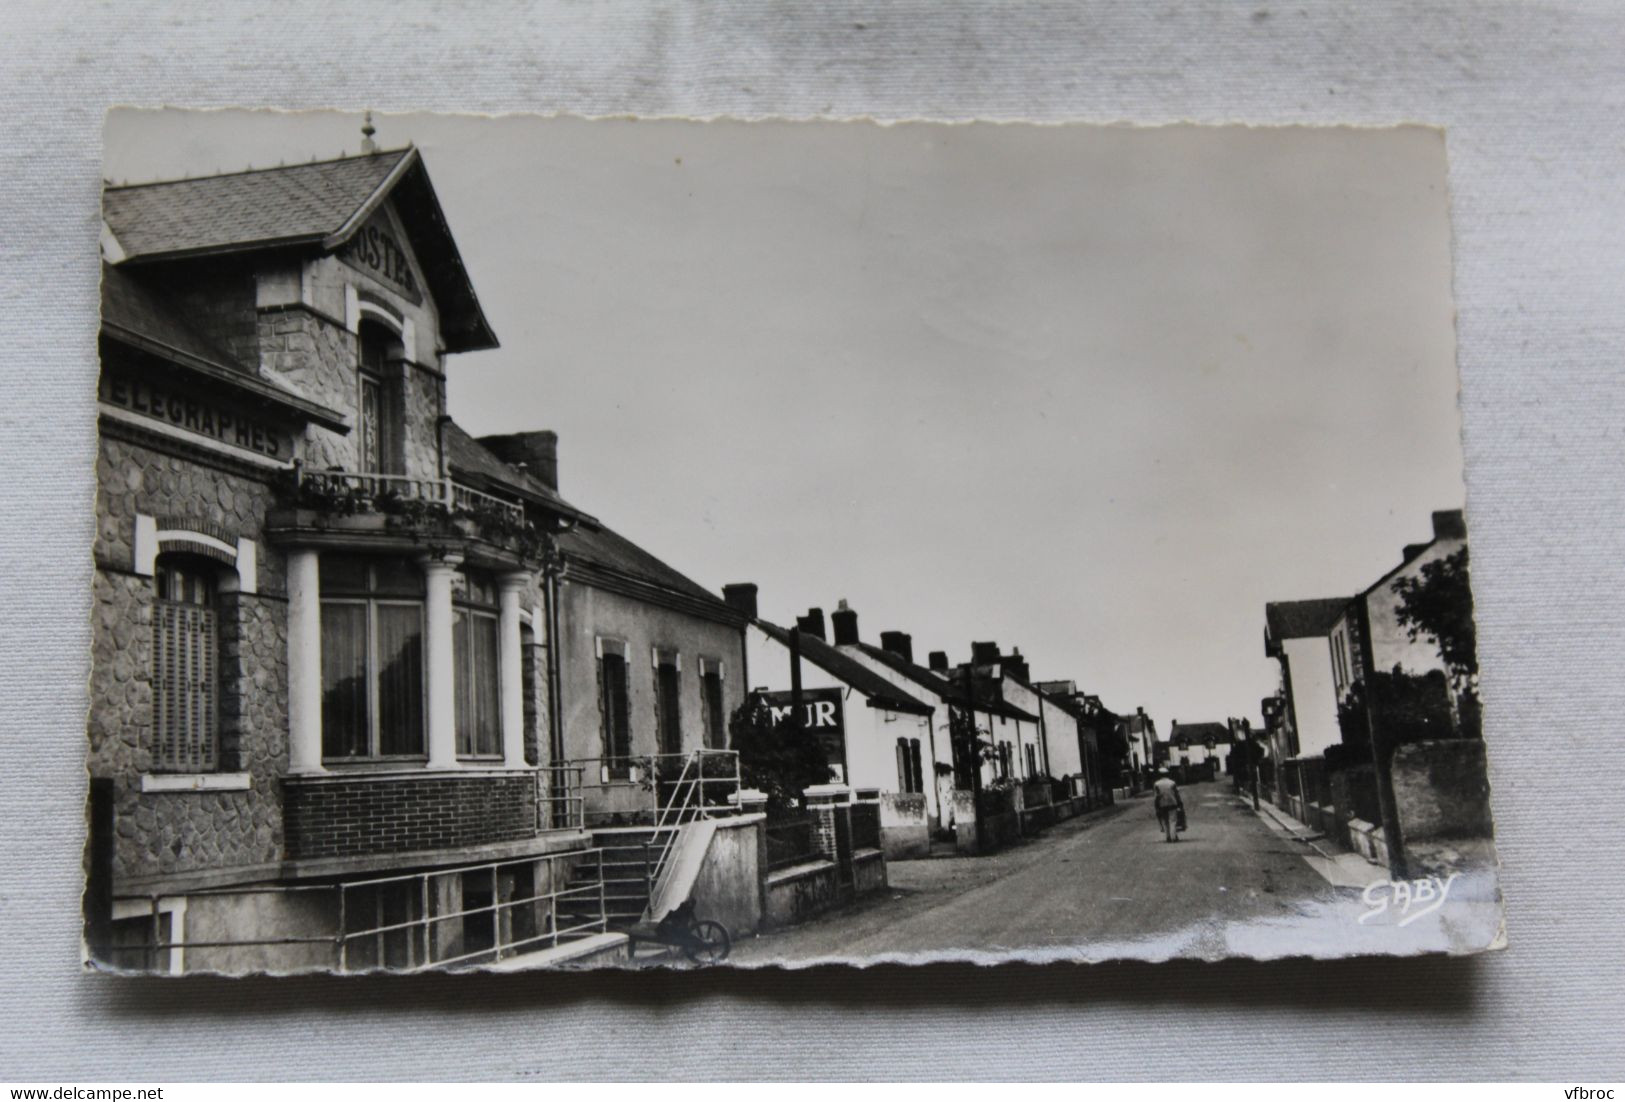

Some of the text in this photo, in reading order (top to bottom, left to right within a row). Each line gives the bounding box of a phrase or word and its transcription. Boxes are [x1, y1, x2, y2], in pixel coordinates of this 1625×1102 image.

[352, 226, 412, 291] OSTES
[103, 376, 279, 455] ELEGRAPHES
[1358, 872, 1464, 927] GABY
